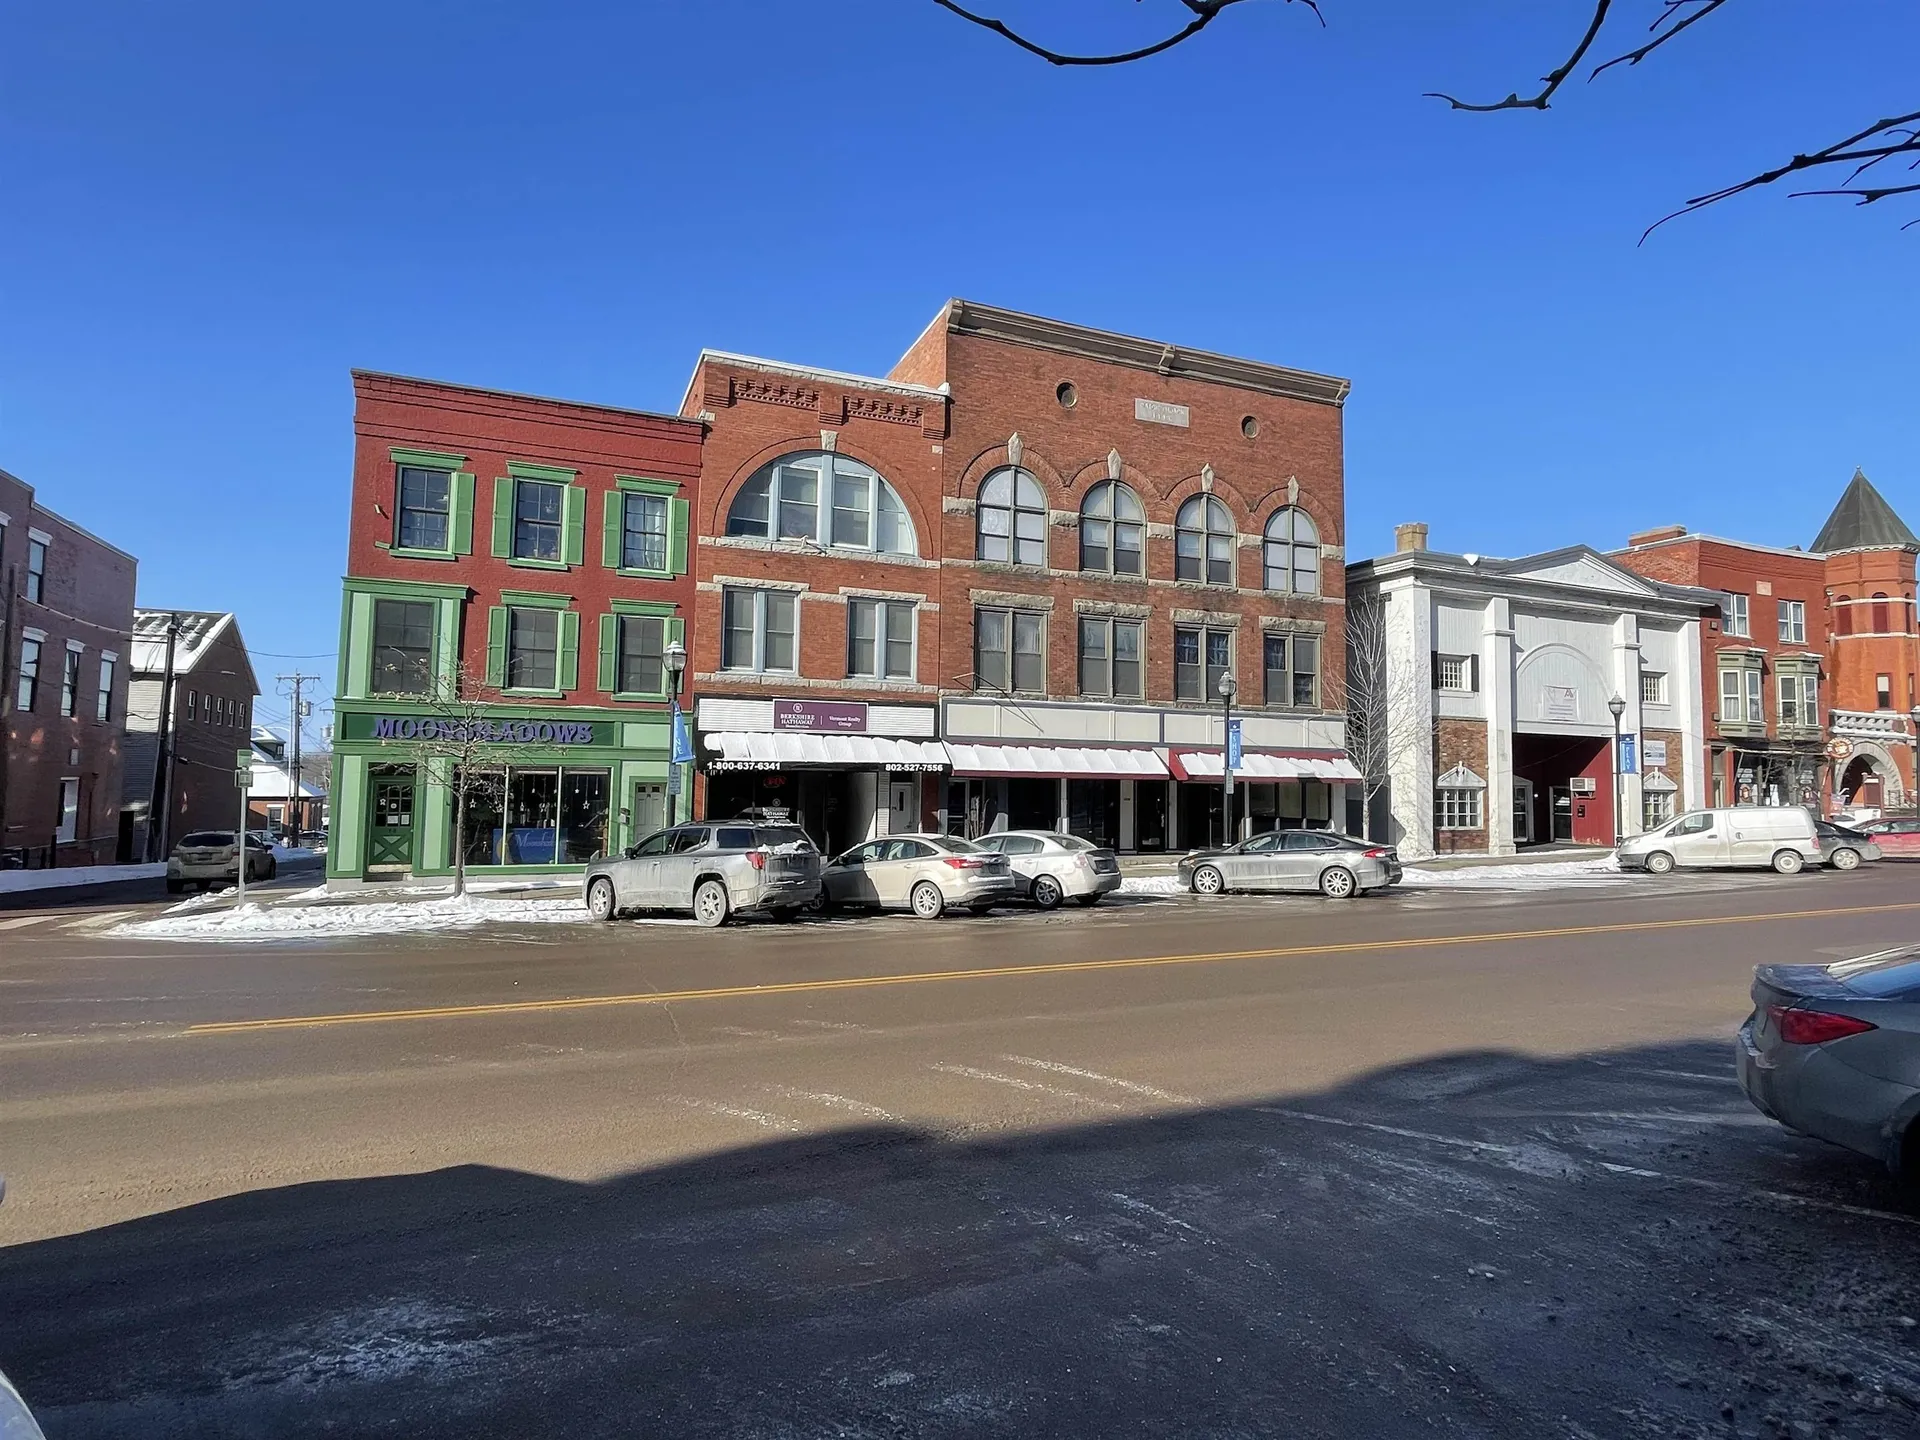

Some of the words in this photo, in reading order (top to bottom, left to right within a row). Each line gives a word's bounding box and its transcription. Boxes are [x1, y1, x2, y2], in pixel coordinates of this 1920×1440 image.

[373, 717, 594, 744] MOONSHADOWS
[707, 762, 781, 771] 1-800-637-6341
[885, 763, 943, 772] 802-527-7556
